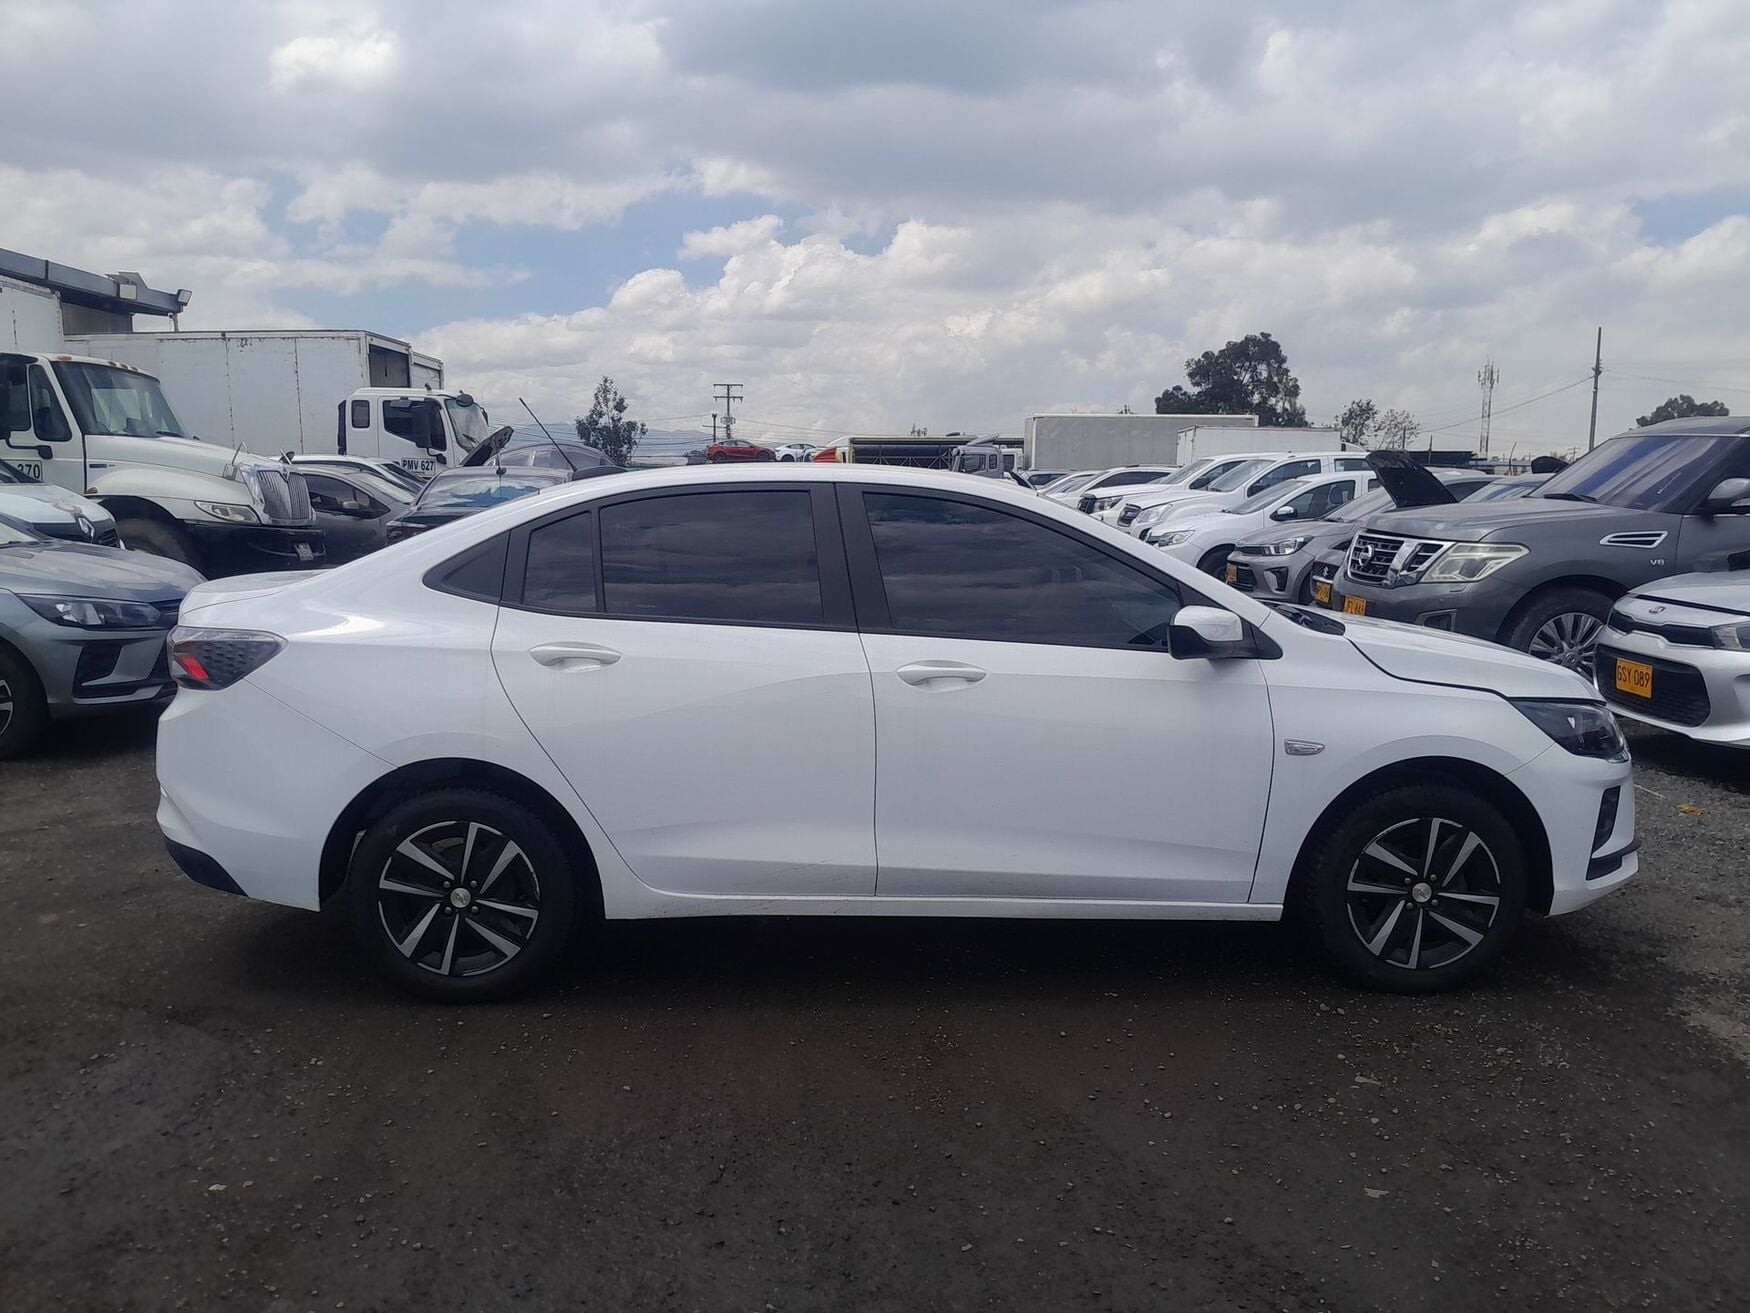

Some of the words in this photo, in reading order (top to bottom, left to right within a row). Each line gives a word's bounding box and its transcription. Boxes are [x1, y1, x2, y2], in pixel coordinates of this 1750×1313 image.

[402, 460, 419, 470] PMV
[421, 460, 435, 471] 627
[1617, 664, 1632, 684] GSY
[1634, 669, 1650, 688] 089
